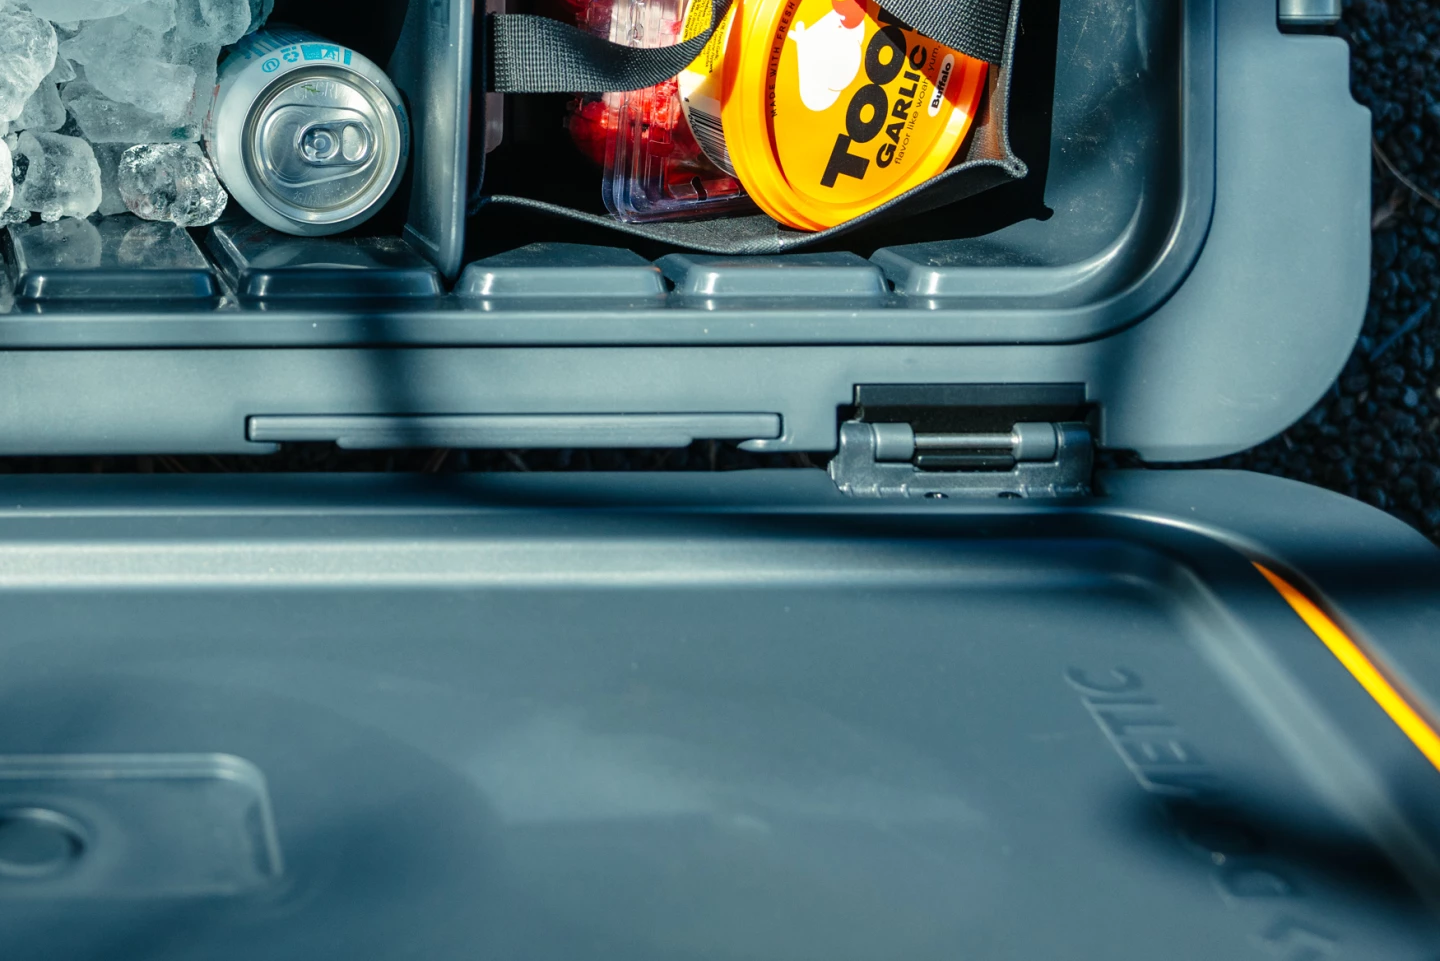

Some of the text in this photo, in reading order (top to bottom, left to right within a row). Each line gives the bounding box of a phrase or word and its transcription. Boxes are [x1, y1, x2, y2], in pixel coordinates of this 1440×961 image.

[776, 1, 795, 41] FRESH
[769, 47, 781, 77] WITH
[931, 62, 952, 109] Buffalo
[768, 84, 777, 118] MADE
[820, 6, 913, 188] TOO
[876, 44, 927, 169] GARLIC
[895, 132, 911, 165] flavor
[907, 111, 919, 131] like
